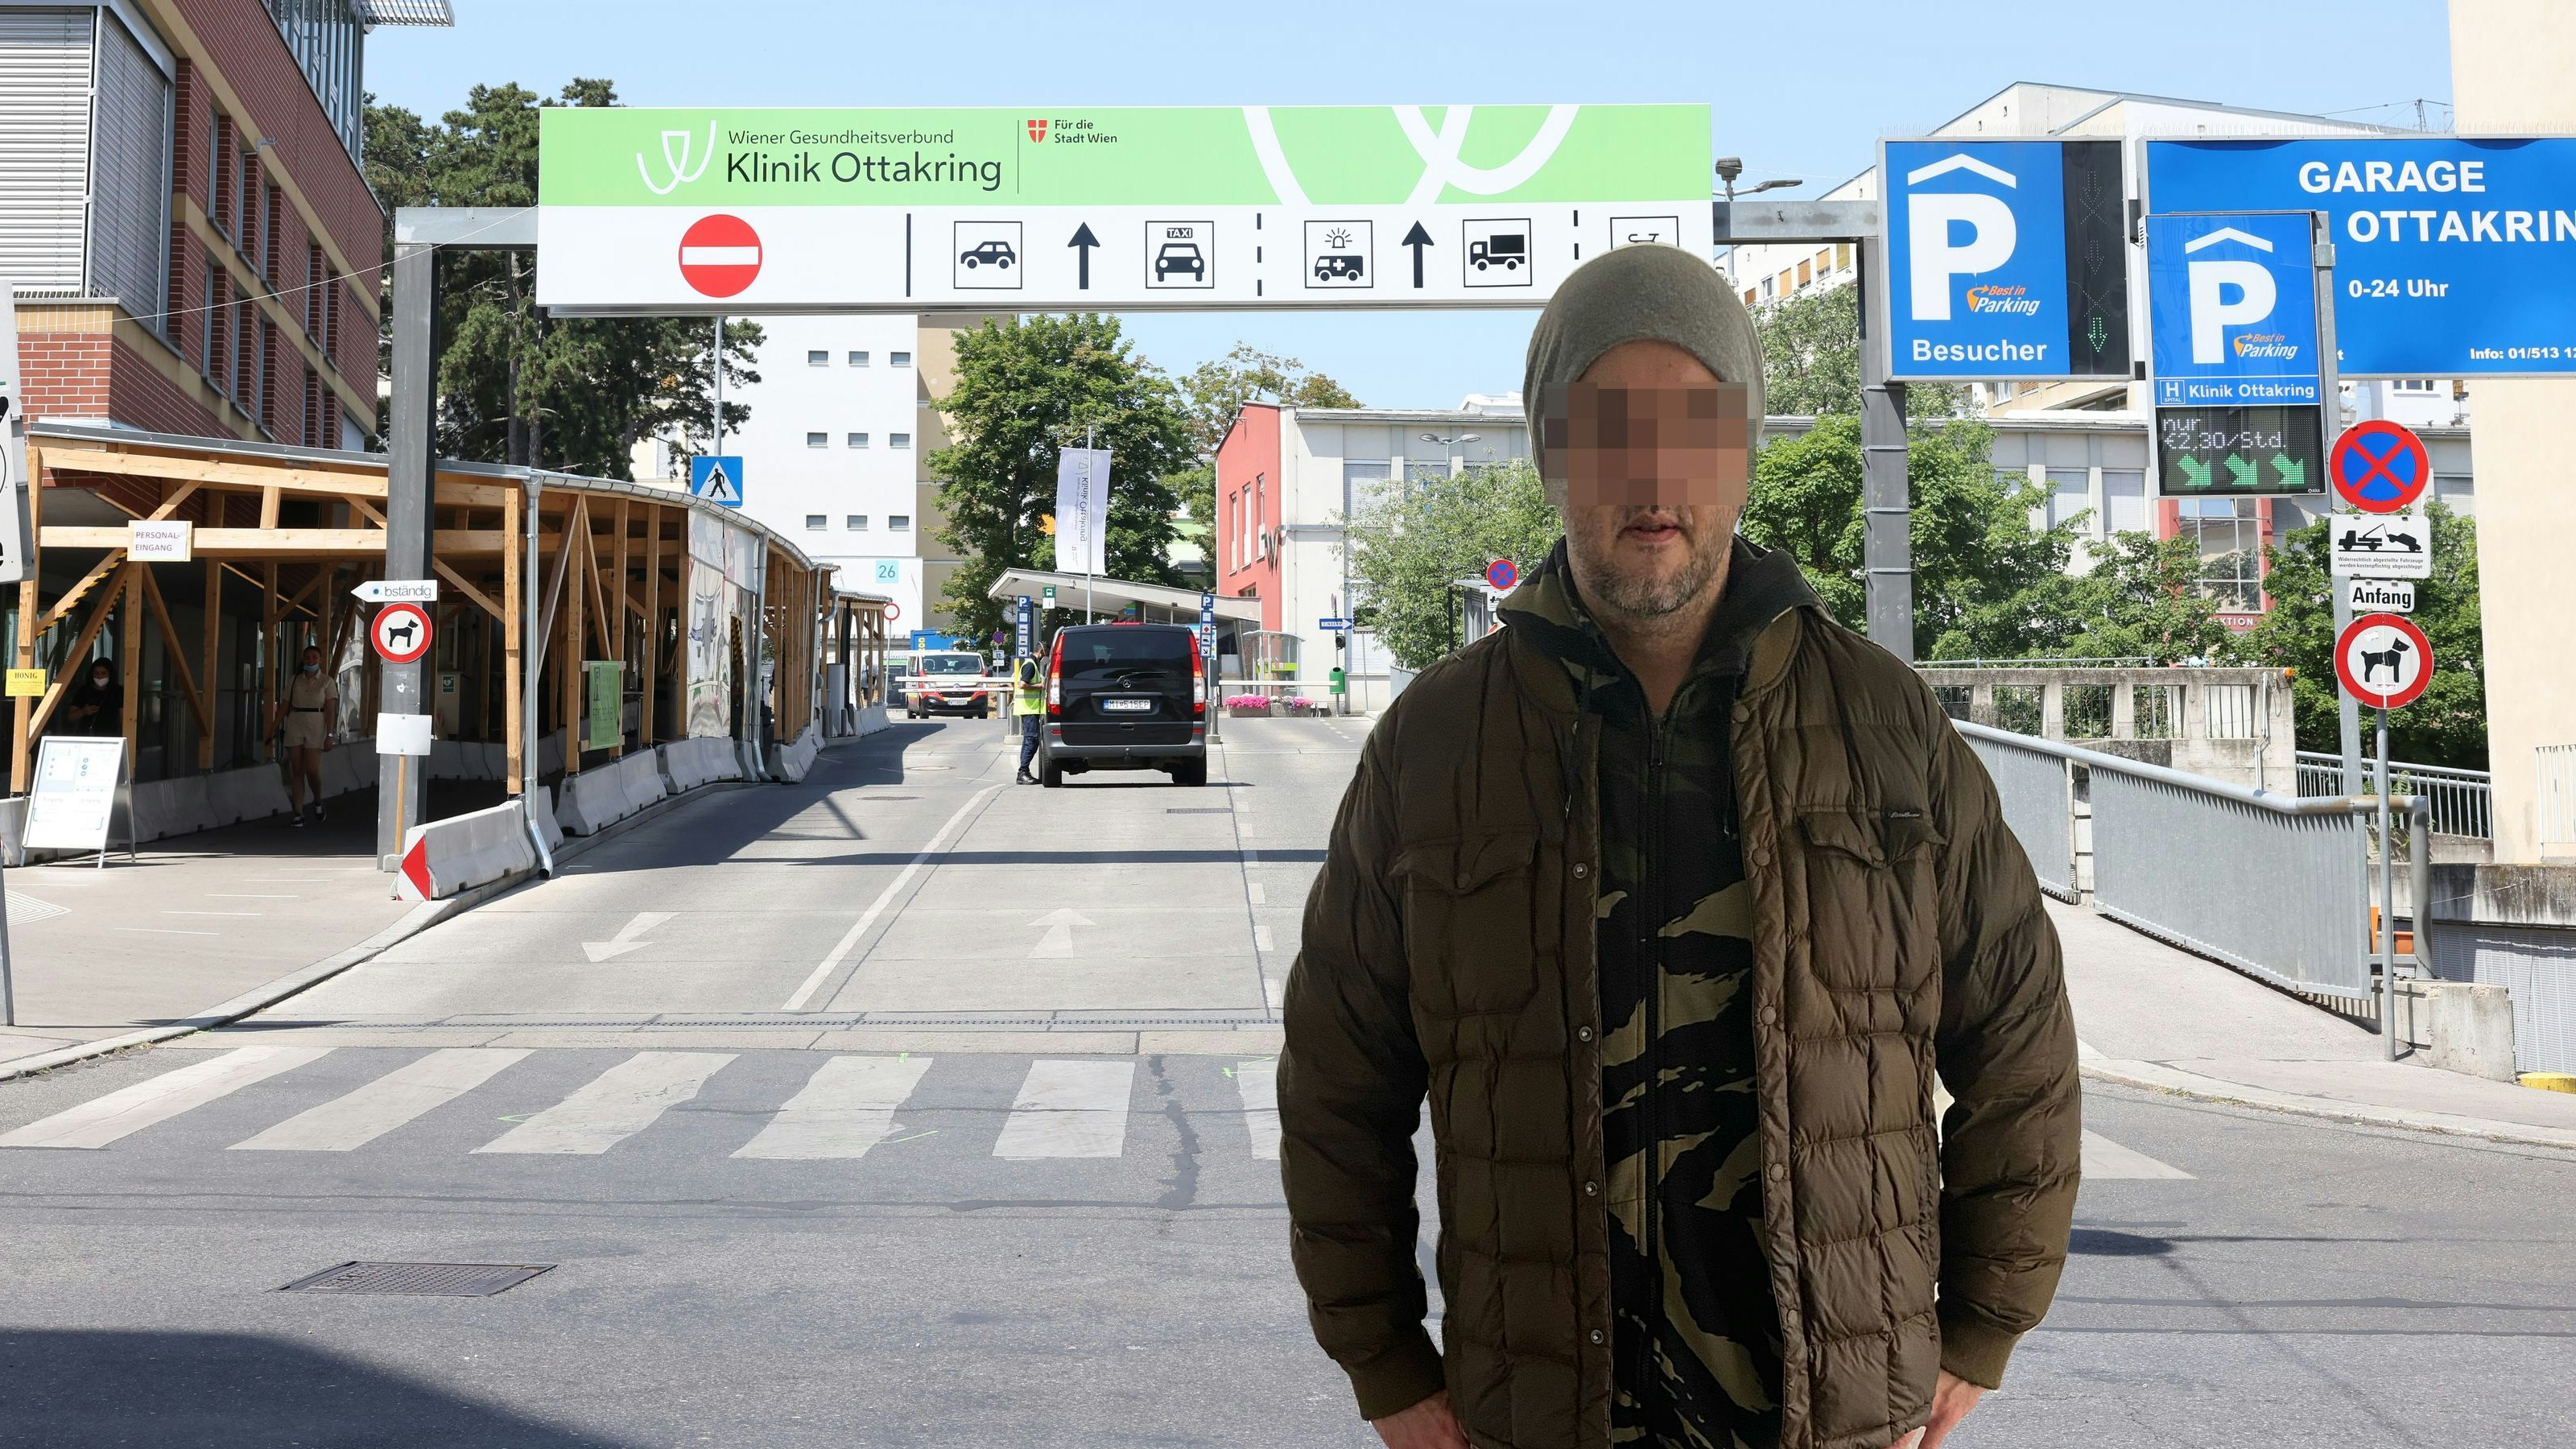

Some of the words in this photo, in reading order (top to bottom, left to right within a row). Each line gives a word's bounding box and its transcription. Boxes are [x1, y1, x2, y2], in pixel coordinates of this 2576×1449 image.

[1055, 119, 1073, 130] Für
[1075, 119, 1094, 130] die
[728, 130, 786, 144] Wiener
[790, 129, 954, 144] Gesundheitsverbund
[1055, 133, 1084, 143] Stadt
[1088, 133, 1117, 143] Wien
[727, 151, 821, 183] Klinik
[832, 151, 1001, 192] Ottakring
[2298, 160, 2486, 193] GARAGE
[1167, 228, 1192, 238] TAXI
[2347, 210, 2576, 242] OTTAKRIN
[1908, 193, 2017, 320] P
[1988, 286, 2013, 296] Best
[2015, 286, 2026, 295] in
[2348, 279, 2400, 298] 0-24
[2407, 279, 2449, 297] Uhr
[1975, 296, 2041, 316] Parking
[2188, 260, 2277, 364] P
[2252, 333, 2274, 342] Best
[2275, 333, 2285, 342] in
[1912, 339, 2047, 361] Besucher
[2240, 343, 2298, 360] Parking
[2470, 348, 2504, 360] Info:
[2508, 346, 2560, 359] 01/513
[2165, 382, 2179, 398] H
[2189, 384, 2233, 398] Klinik
[2238, 383, 2314, 398] Ottakring
[2162, 418, 2202, 431] nur
[2163, 431, 2287, 452] €2,30/Std.
[135, 531, 180, 539] PERSONAL-
[135, 543, 172, 551] EINGANG
[878, 565, 896, 578] 26
[384, 584, 431, 598] bständig
[2352, 587, 2411, 609] Anfang
[14, 671, 38, 679] HONIG
